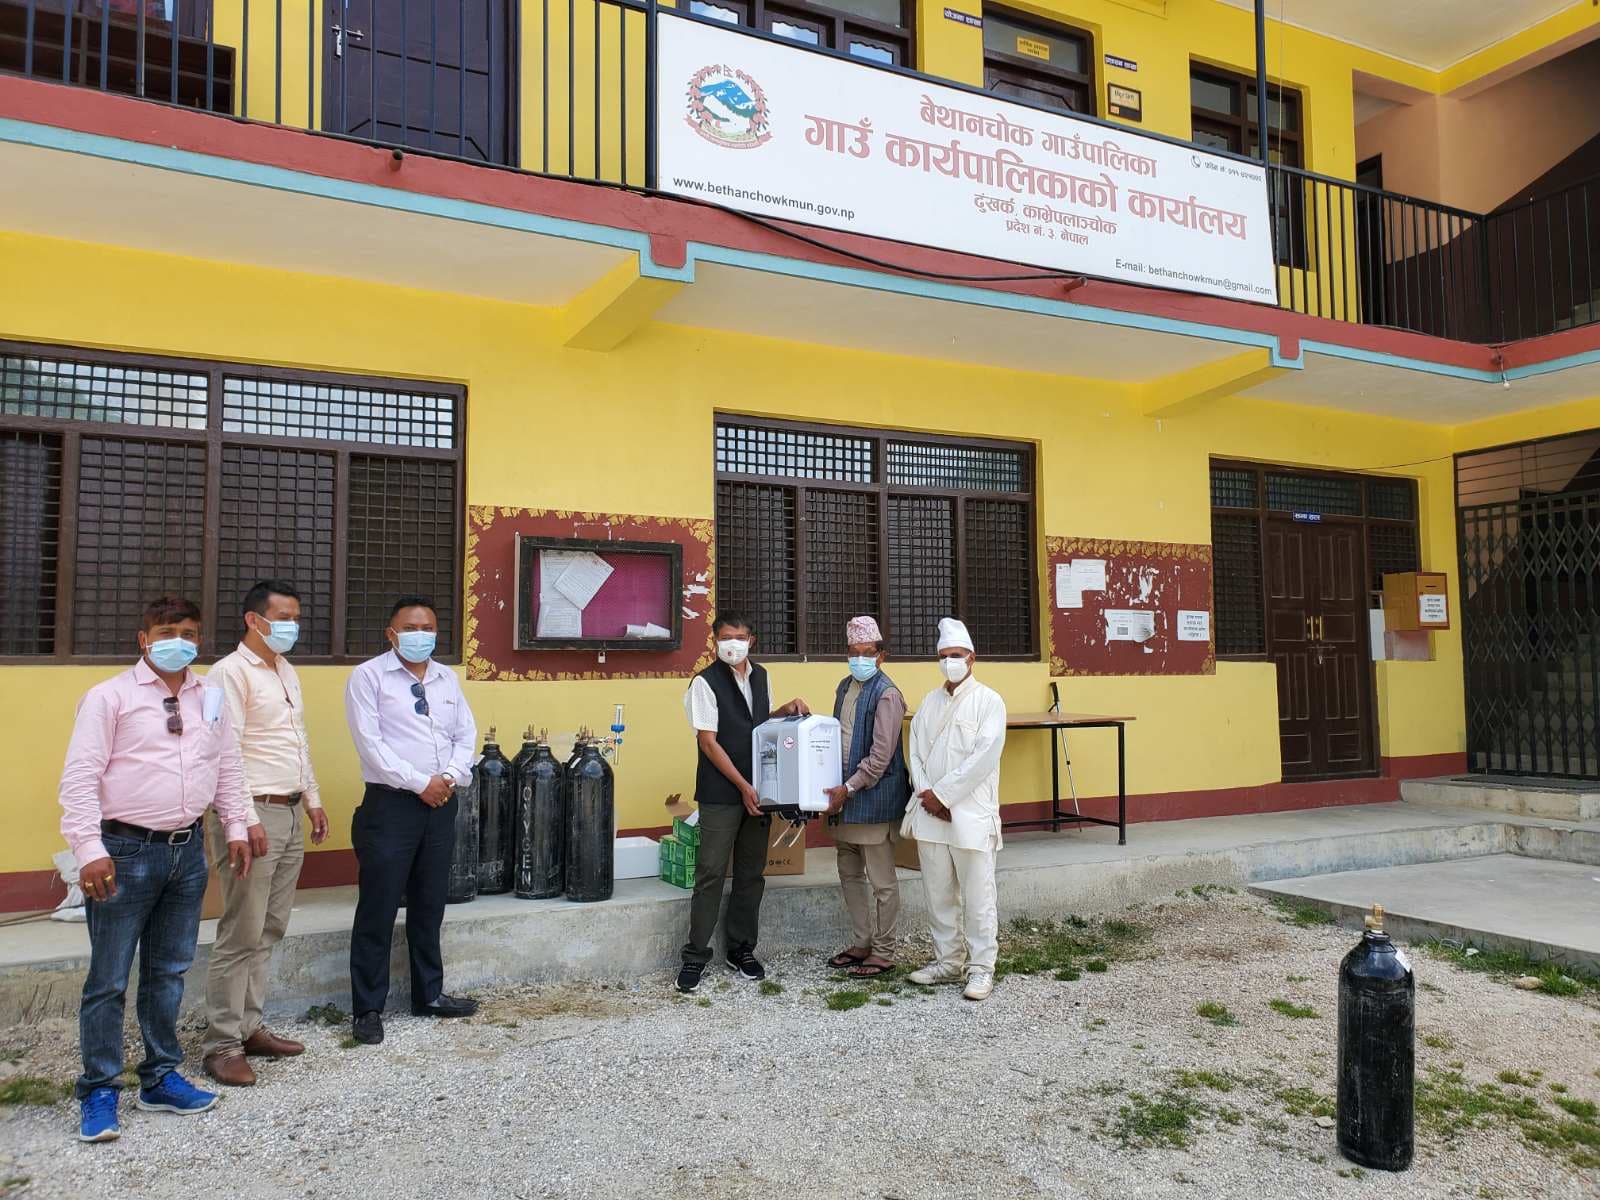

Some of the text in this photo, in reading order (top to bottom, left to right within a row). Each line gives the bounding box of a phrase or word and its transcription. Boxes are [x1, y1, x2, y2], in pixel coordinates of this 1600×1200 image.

[920, 95, 1156, 178] बेथानचोक गाउँपालिका
[673, 177, 855, 221] www.bethanchowkmun.gov.np
[805, 115, 874, 159] गाउँ
[885, 133, 1119, 212] कार्यपालिकाको
[1128, 188, 1248, 240] कार्यालय
[1006, 218, 1030, 233] प्रदेश
[1060, 229, 1089, 245] नेपाल
[1115, 258, 1273, 296] E-mail: bethanchowkmun@gmail.com
